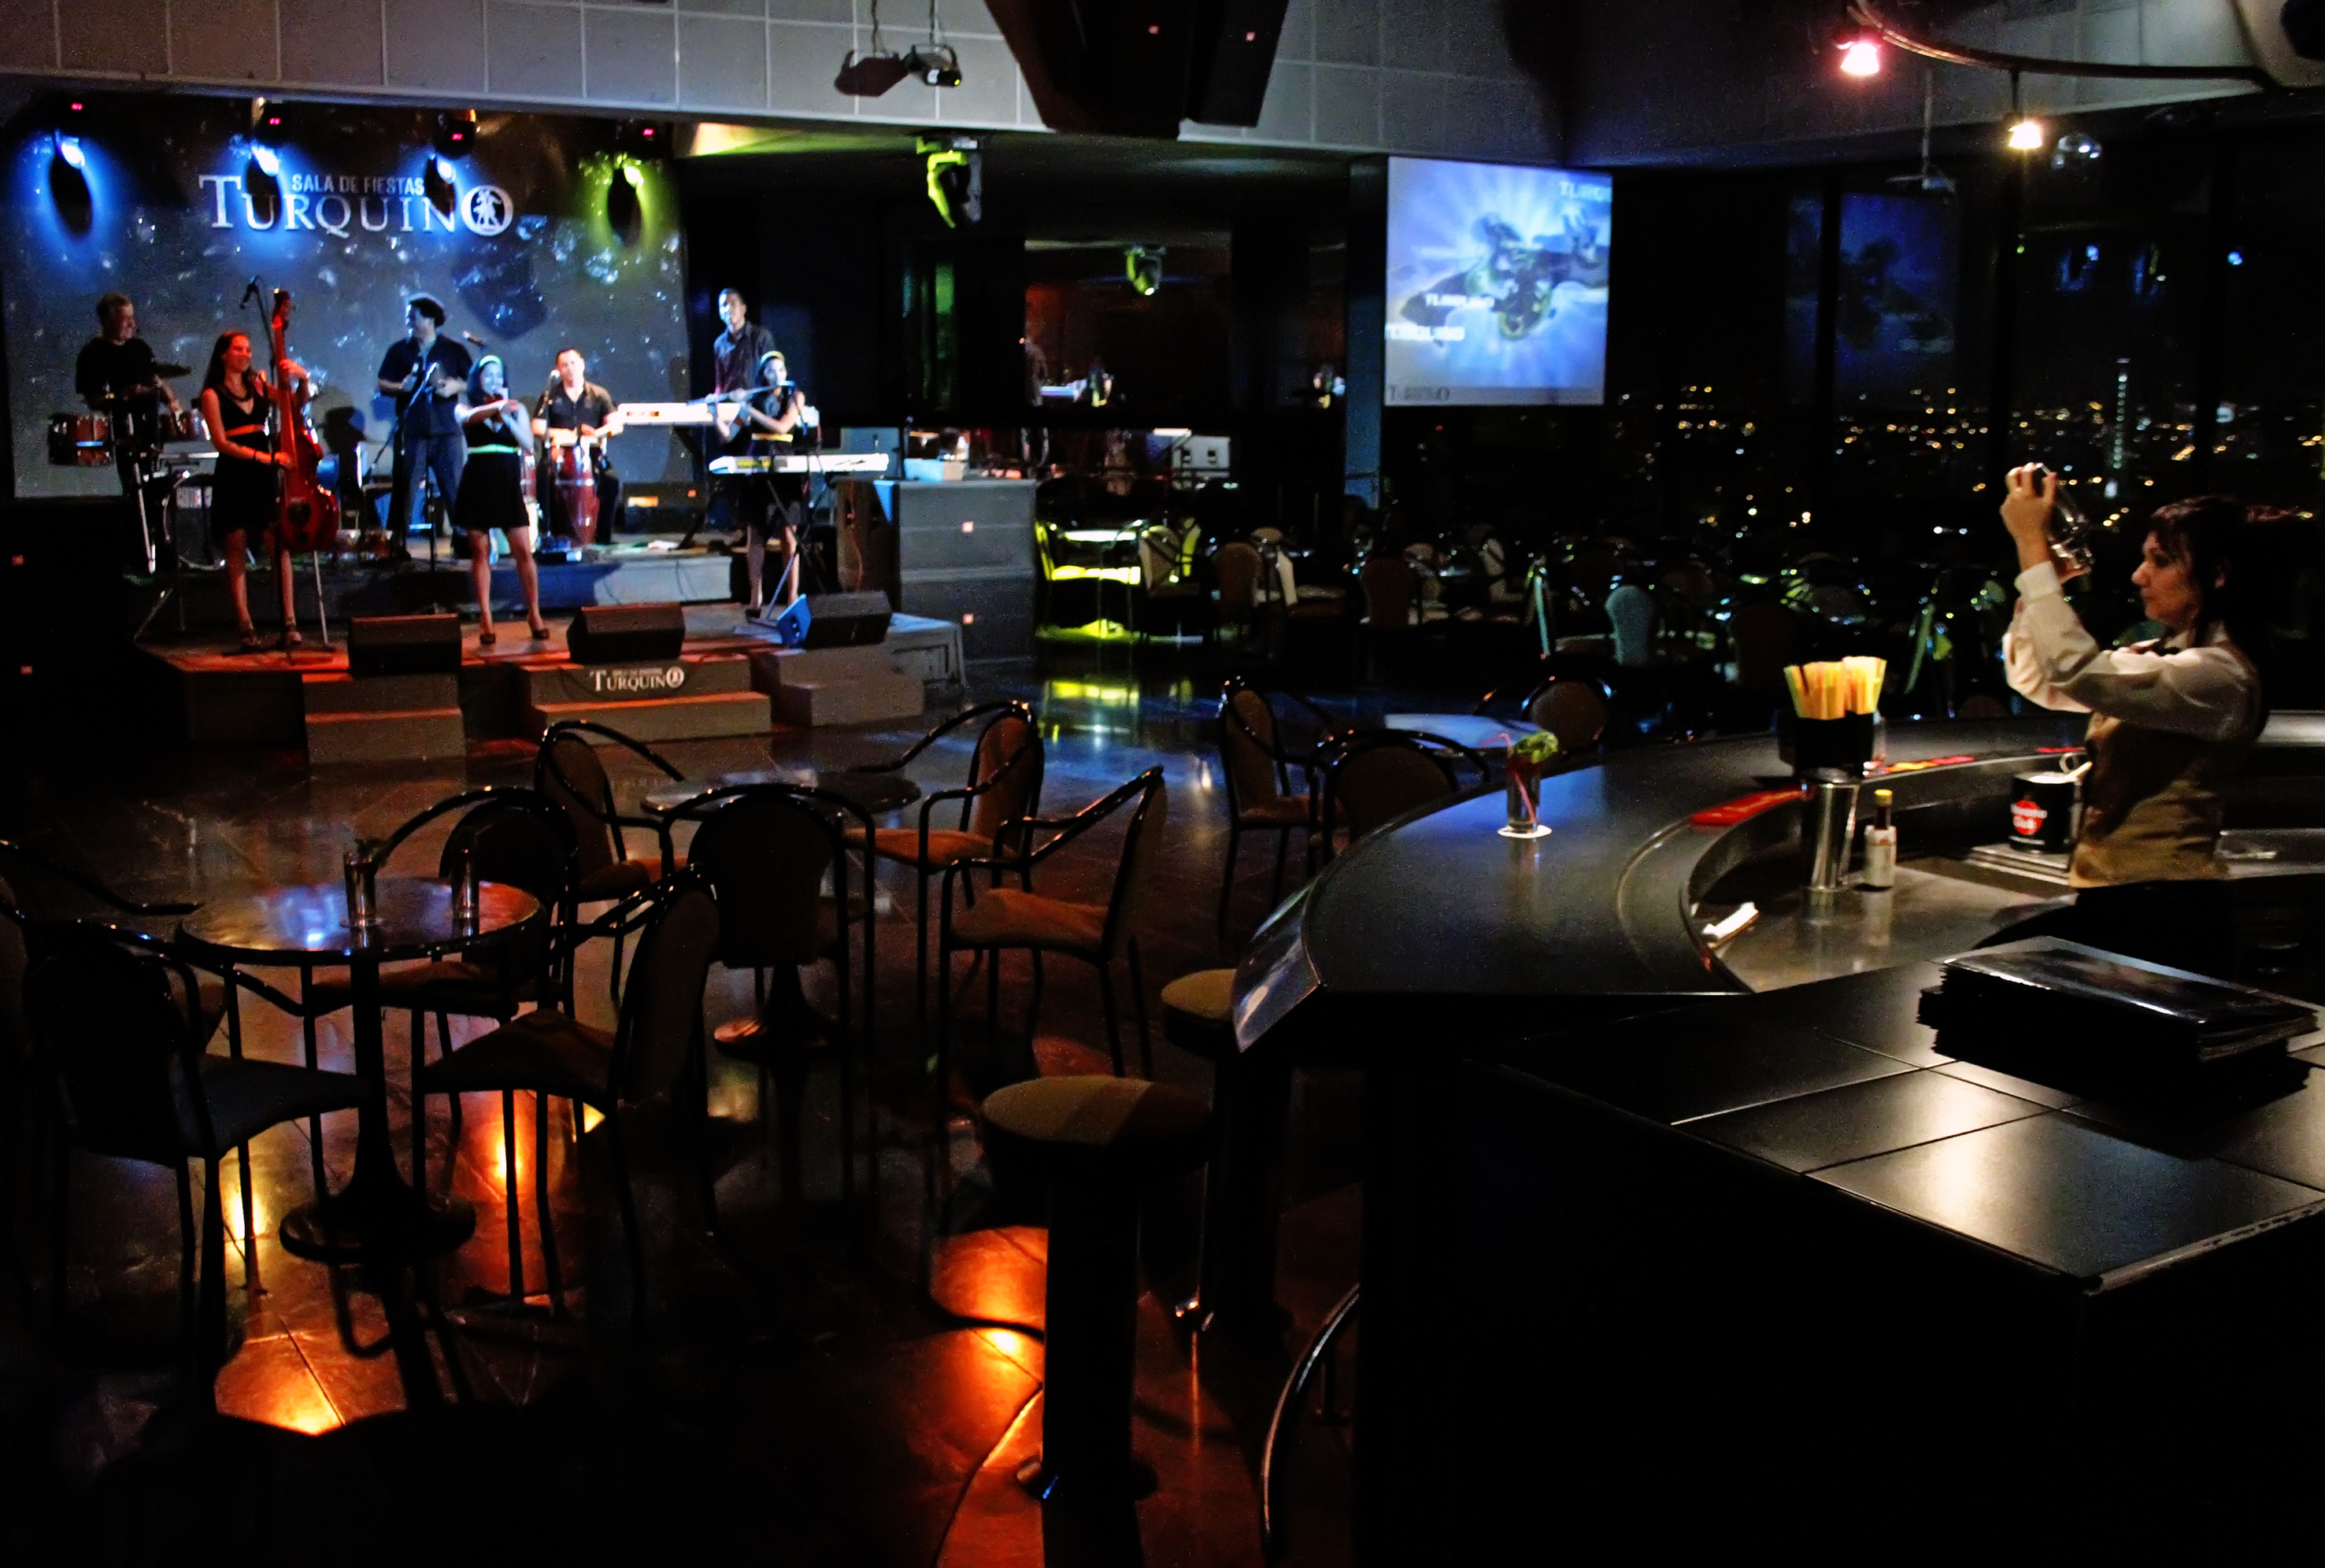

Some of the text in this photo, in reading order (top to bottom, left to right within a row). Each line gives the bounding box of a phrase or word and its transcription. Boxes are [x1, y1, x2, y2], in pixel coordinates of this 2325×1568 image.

[291, 173, 425, 196] SALA DE FIESTAS
[198, 174, 514, 239] TURQUINO
[591, 666, 685, 692] TURQUINO
